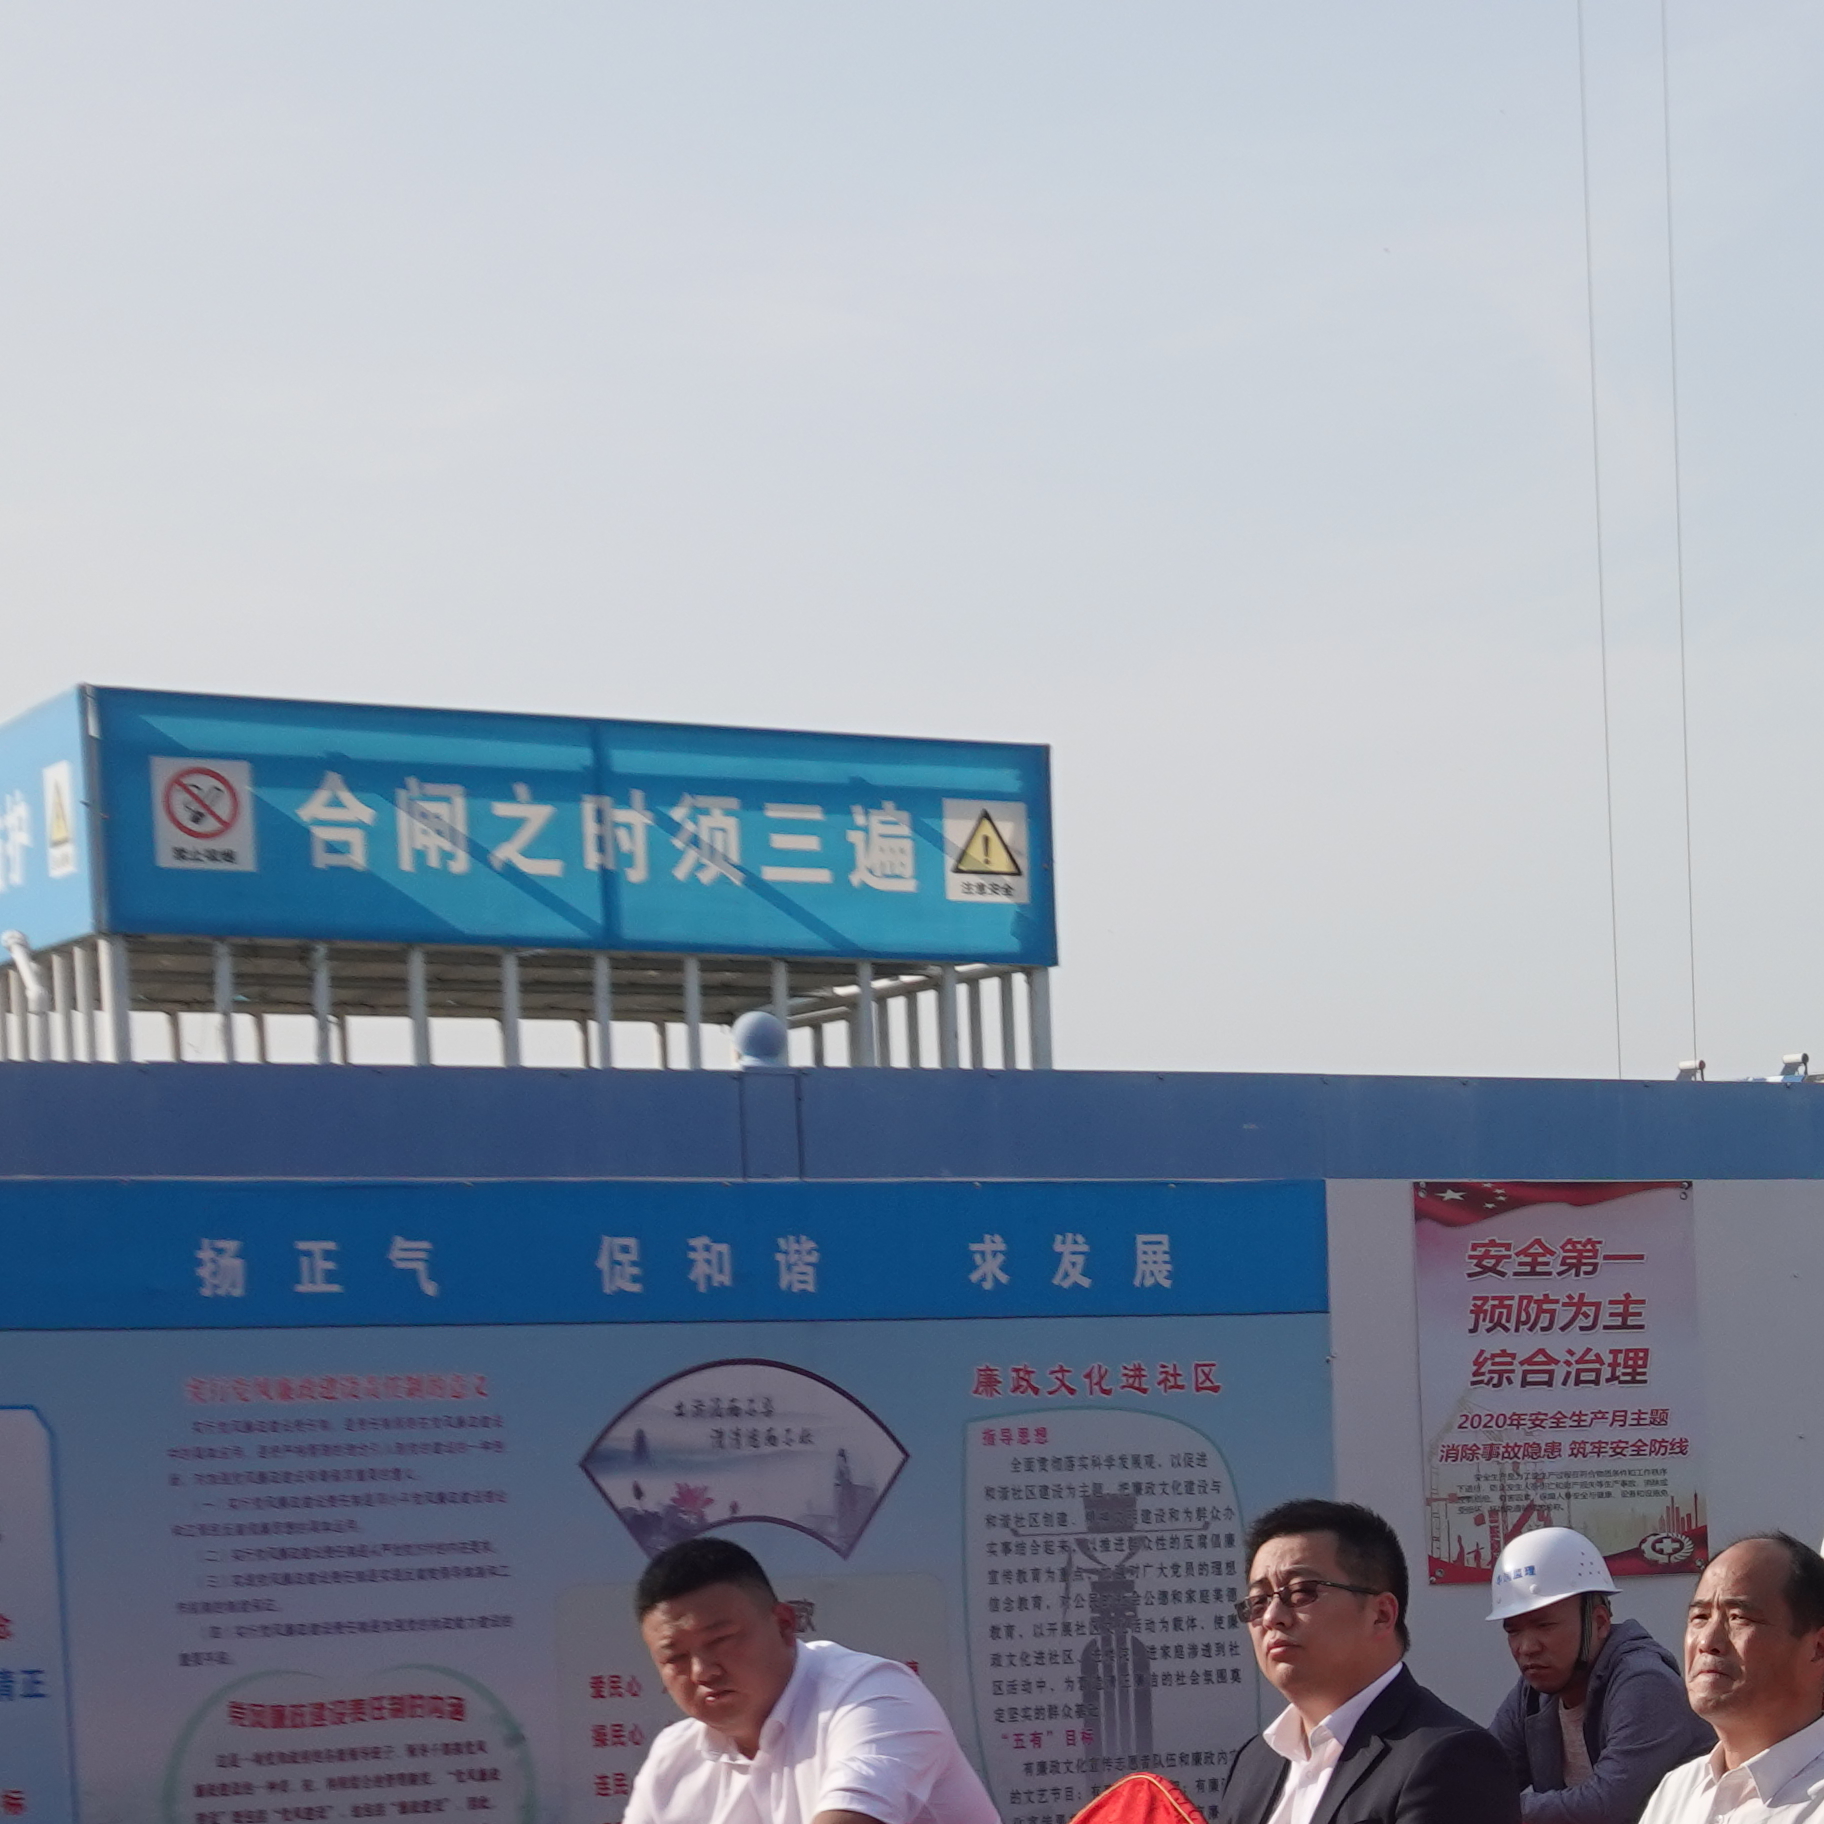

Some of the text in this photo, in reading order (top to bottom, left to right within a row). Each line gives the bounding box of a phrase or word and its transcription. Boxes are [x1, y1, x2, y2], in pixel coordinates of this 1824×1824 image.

[295, 771, 918, 894] 合闸之时须三遍
[960, 881, 1015, 896] 注意安全
[195, 1234, 1175, 1297] 扬正气 促和谐 求发展
[1466, 1238, 1646, 1279] 安全第一
[1468, 1293, 1646, 1334] 预防为主
[972, 1361, 1223, 1398] 廉政文化进社区
[1470, 1347, 1650, 1389] 综合治理
[981, 1427, 1050, 1446] 指导思想
[1457, 1408, 1670, 1431] 2020年安全生产月主题
[1439, 1437, 1689, 1464] 消除事故隐患 筑牢安全防线
